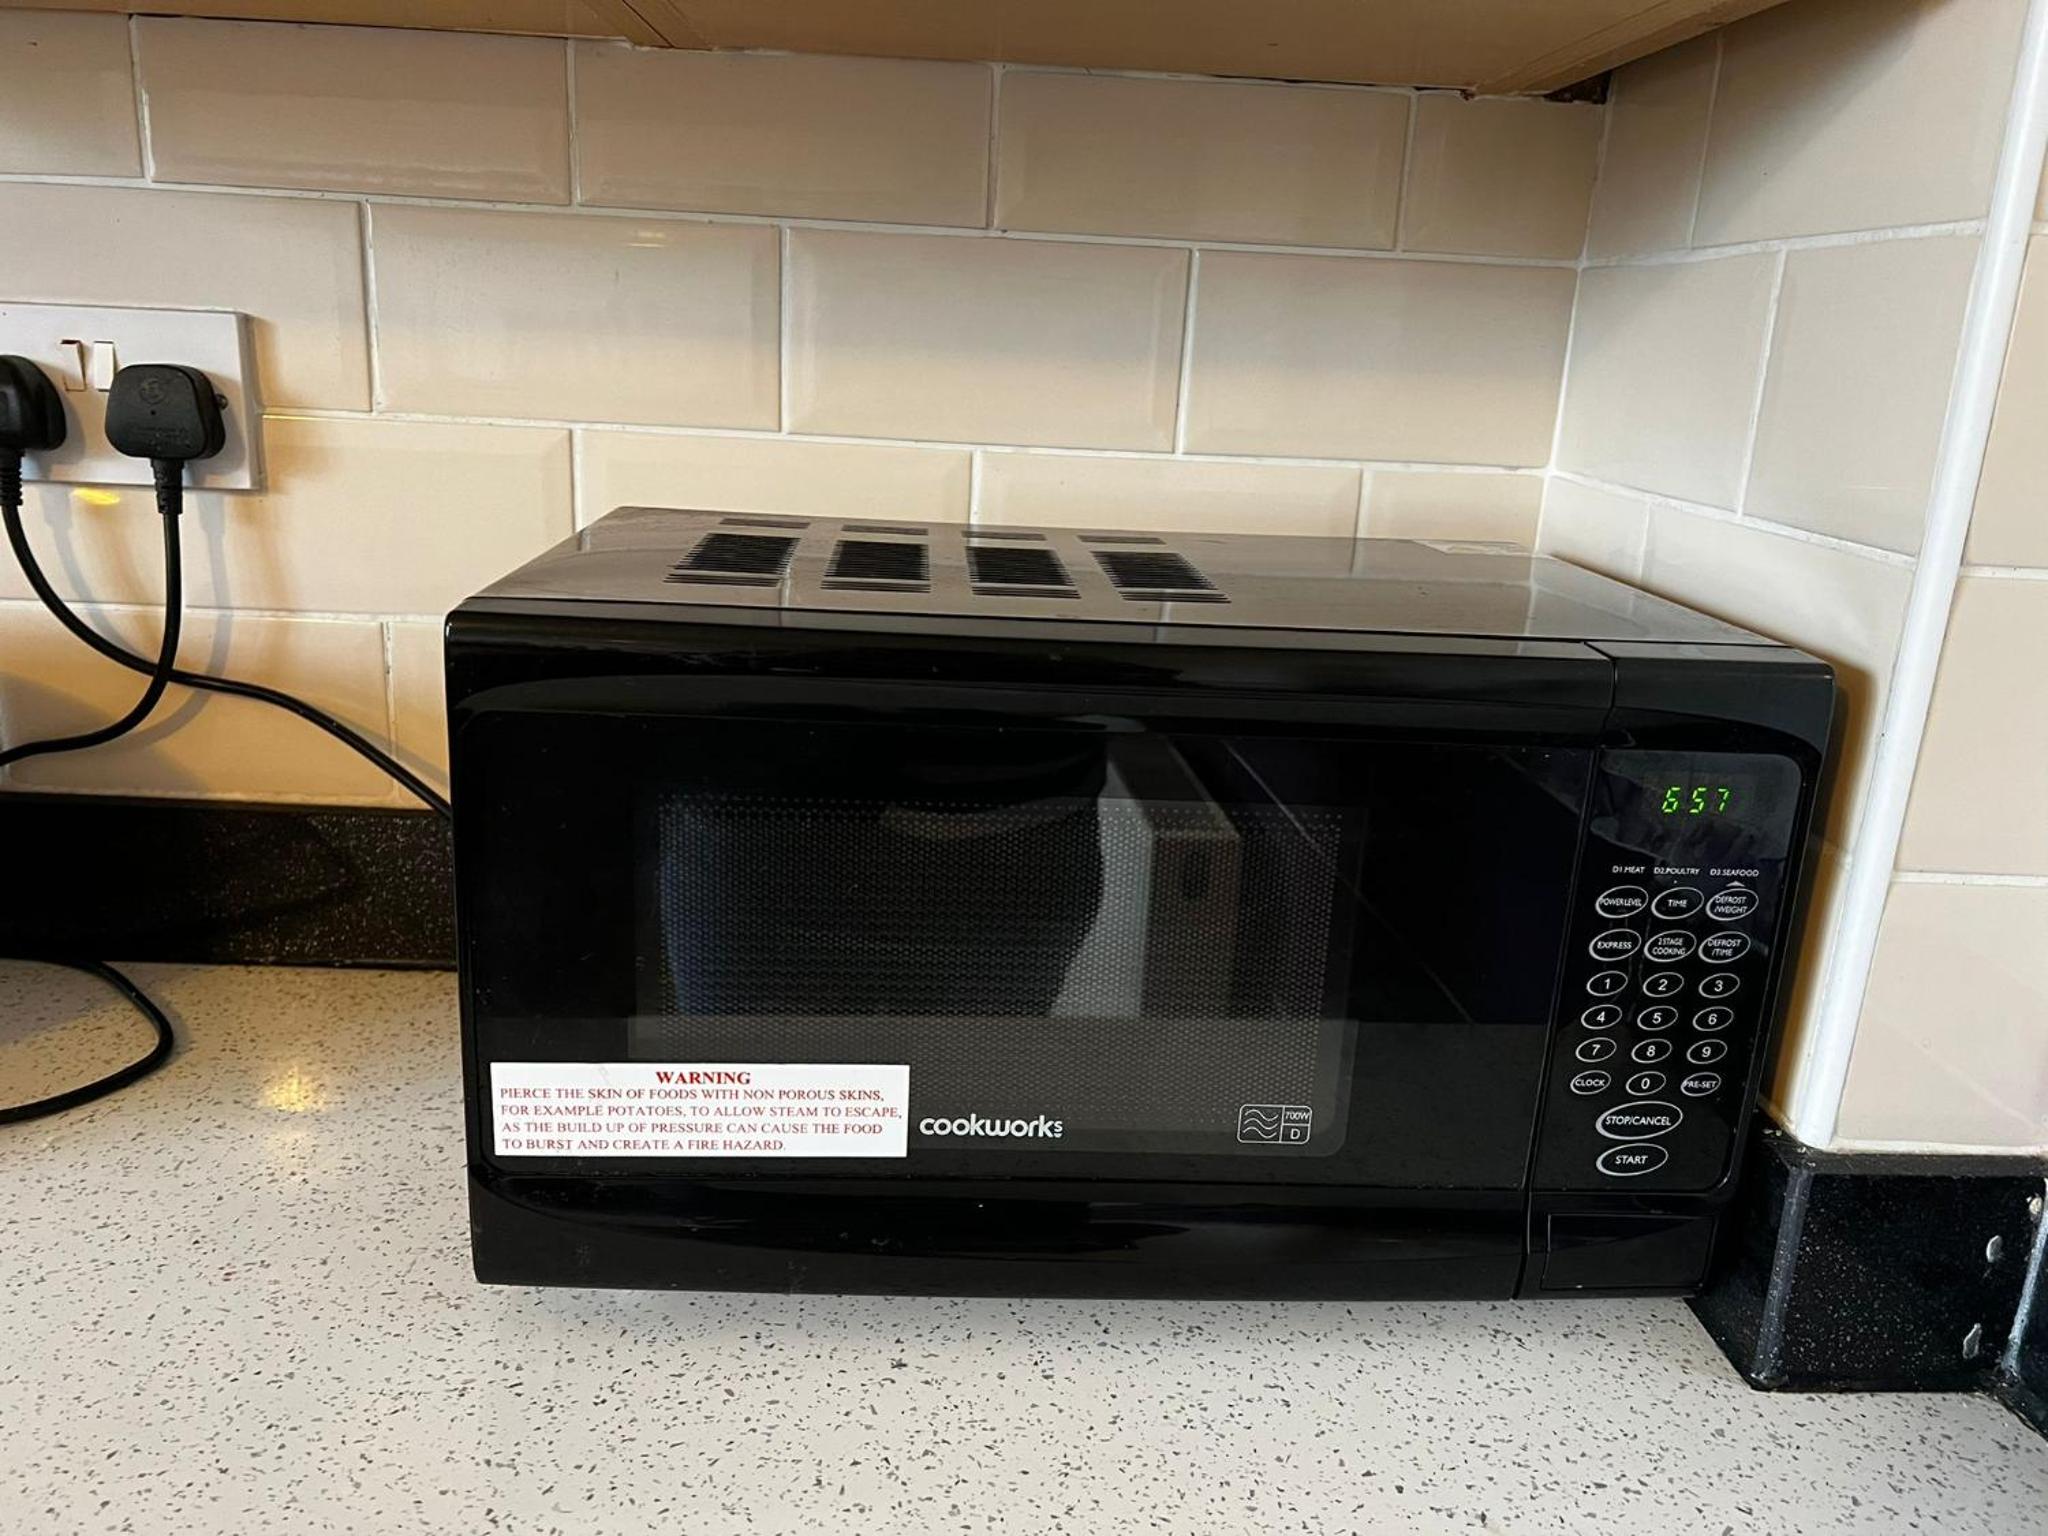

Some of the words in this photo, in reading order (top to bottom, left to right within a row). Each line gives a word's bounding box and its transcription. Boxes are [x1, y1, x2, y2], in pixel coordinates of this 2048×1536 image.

[1668, 899, 1688, 908] TIME
[1714, 896, 1747, 904] DEFROST
[1597, 941, 1632, 950] EXPRESS
[1707, 939, 1742, 947] DEFROST
[1652, 947, 1686, 956] COOKING
[1604, 978, 1611, 989] 1
[1657, 978, 1668, 991] 2
[1714, 980, 1724, 992] 3
[1596, 1011, 1606, 1023] 4
[1652, 1012, 1662, 1024] 5
[1708, 1013, 1717, 1025] 6
[1592, 1044, 1601, 1056] 7
[1646, 1045, 1656, 1057] 8
[1702, 1046, 1711, 1058] 9
[656, 1071, 751, 1085] WARNING
[1575, 1078, 1606, 1087] CLOCK
[1641, 1077, 1650, 1090] 0
[1684, 1080, 1717, 1089] PRE-SET
[500, 1088, 551, 1099] PIERCE
[555, 1088, 584, 1099] THE
[587, 1088, 623, 1099] SKIN
[626, 1089, 646, 1099] OF
[649, 1089, 698, 1100] FOODS
[701, 1089, 739, 1100] WITH
[743, 1089, 775, 1100] NON
[778, 1090, 836, 1101] POROUS
[500, 1105, 529, 1116] FOR
[534, 1105, 603, 1116] EXAMPLE
[608, 1106, 687, 1118] POTATOES,
[691, 1106, 710, 1117] TO
[713, 1106, 766, 1117] ALLOW
[769, 1107, 818, 1117] STEAM
[823, 1107, 842, 1118] TO
[1285, 1111, 1311, 1121] 700W
[919, 1113, 1063, 1139] cookworks
[1605, 1115, 1672, 1127] STOP/CANCEL
[502, 1122, 521, 1133] AS
[525, 1122, 553, 1133] THE
[557, 1122, 603, 1133] BUILD
[606, 1123, 625, 1133] UP
[628, 1123, 648, 1133] OF
[651, 1123, 723, 1133] PRESSURE
[726, 1123, 758, 1133] CAN
[761, 1123, 808, 1134] CAUSE
[812, 1123, 840, 1134] THE
[843, 1123, 883, 1135] FOOD
[1290, 1128, 1301, 1140] D
[502, 1138, 523, 1149] TO
[526, 1138, 572, 1150] BURST
[577, 1139, 610, 1150] AND
[612, 1139, 670, 1150] CREATE
[673, 1139, 684, 1150] A
[687, 1139, 719, 1150] FIRE
[1615, 1155, 1649, 1164] START
